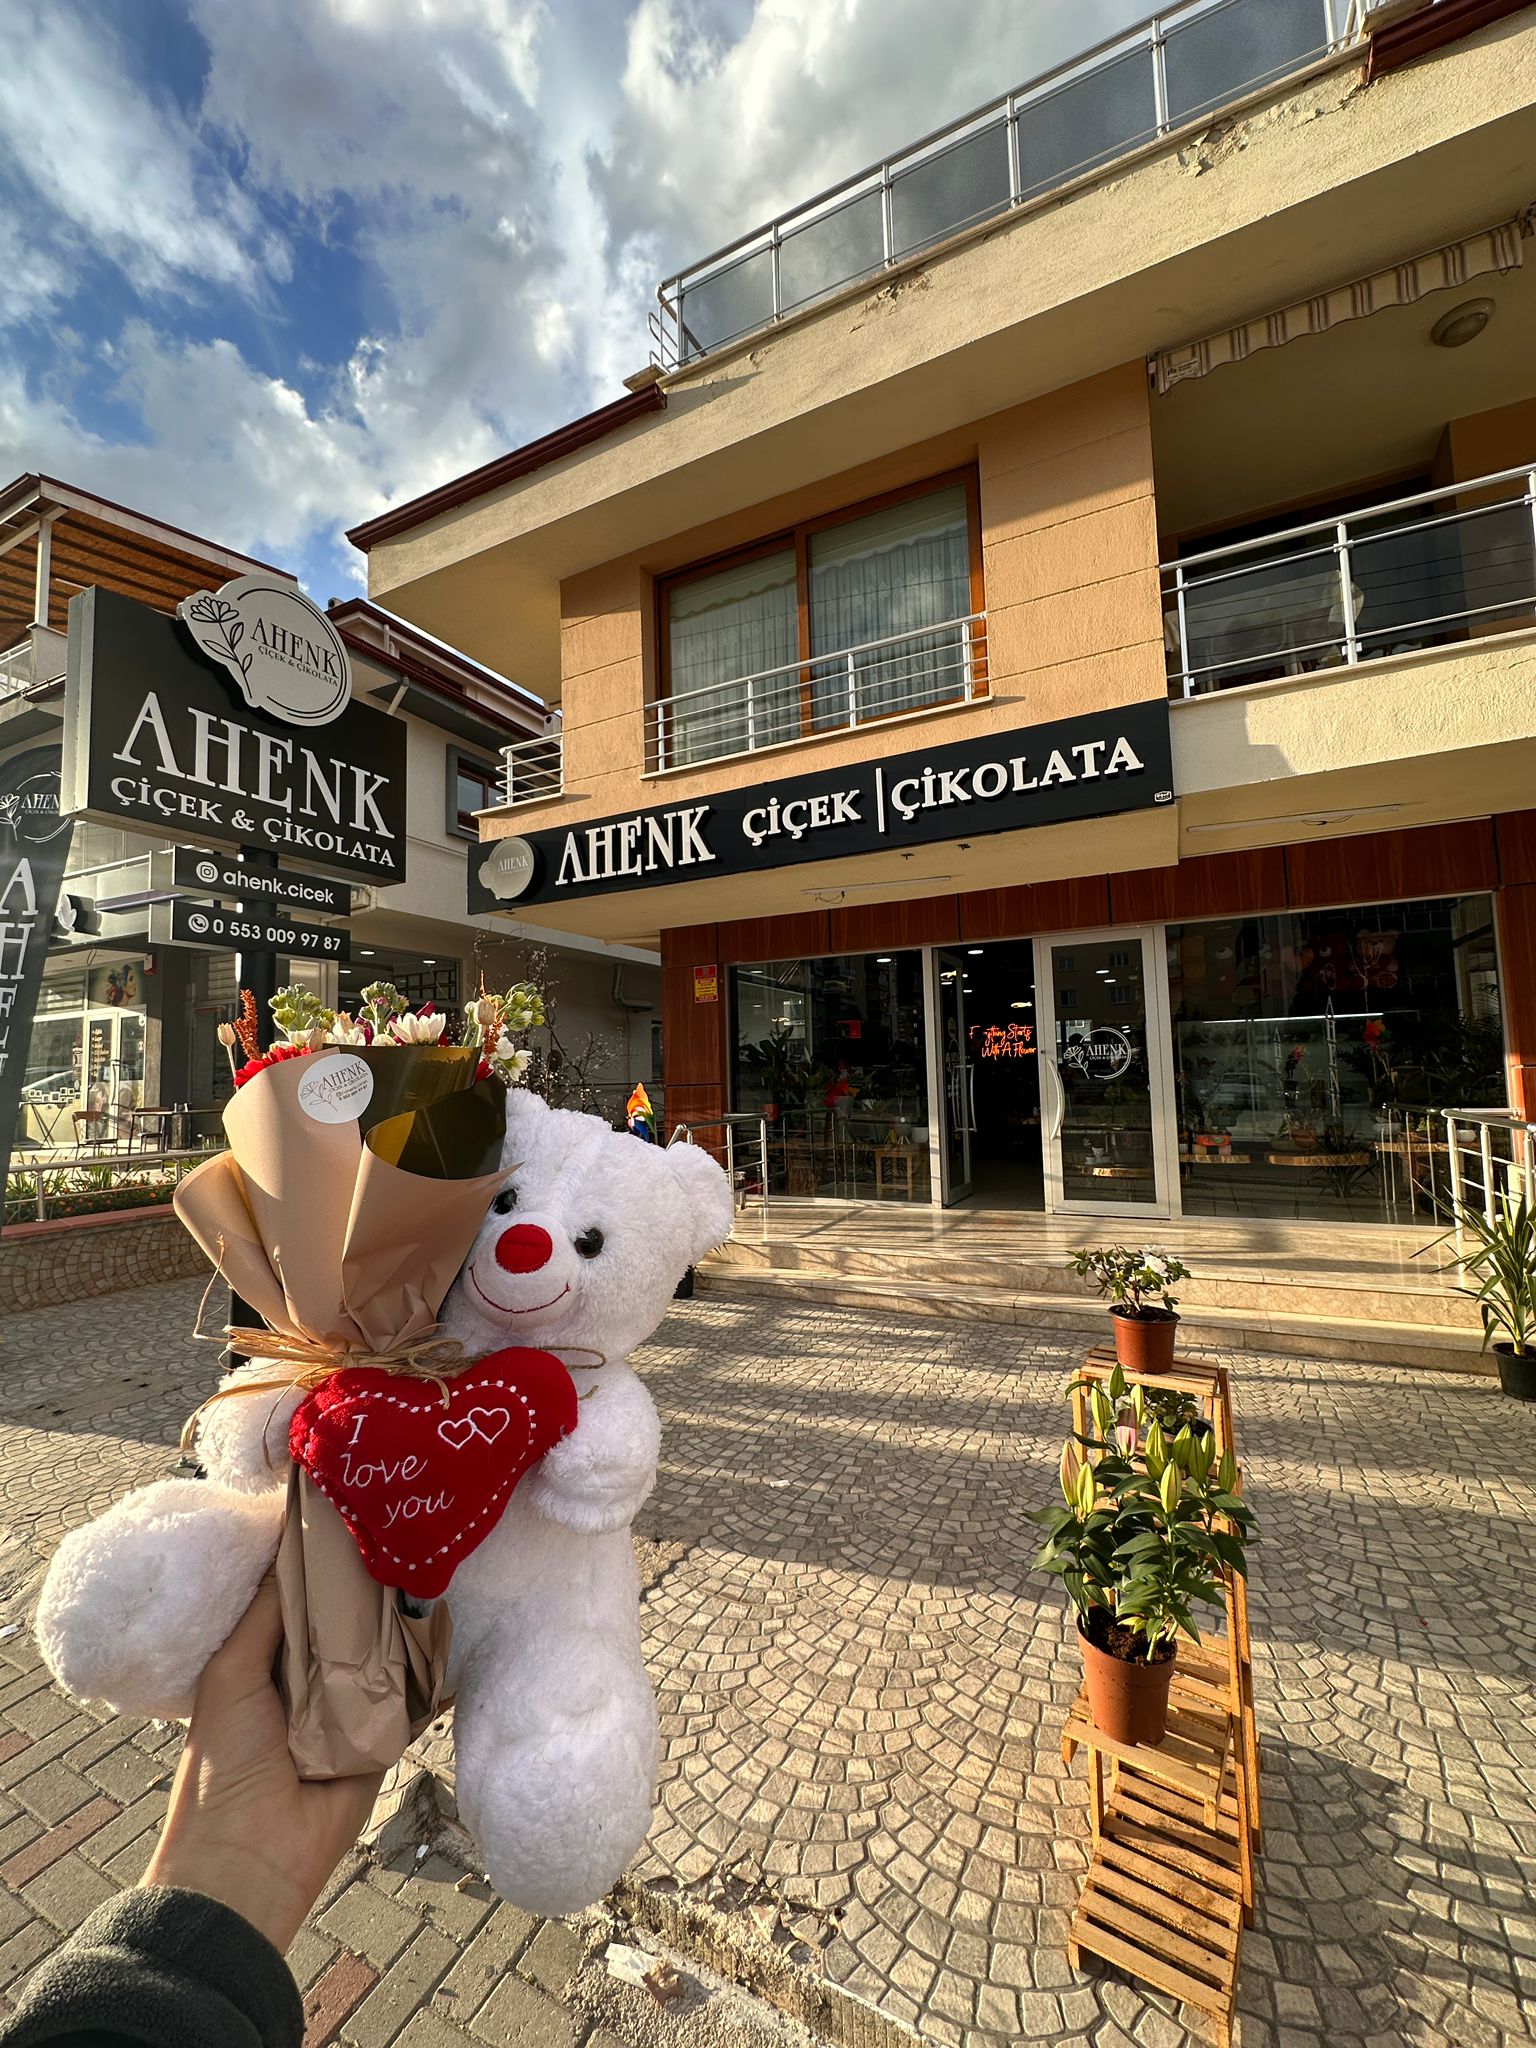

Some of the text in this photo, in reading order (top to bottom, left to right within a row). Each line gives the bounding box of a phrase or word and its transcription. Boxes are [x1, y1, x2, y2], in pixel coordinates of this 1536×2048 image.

[250, 617, 339, 679] AHENK
[288, 659, 294, 667] &
[296, 662, 338, 686] ÇİKOLATA
[112, 691, 395, 839] AHENK
[21, 793, 60, 809] AHEN
[555, 736, 1144, 885] AHENK ÇİÇEK ÇİKOLATA
[110, 776, 396, 868] ÇİÇEK & ÇİKOLATA
[497, 855, 529, 873] AHENK
[223, 870, 334, 904] ahenk.cicek
[213, 918, 341, 951] 0 553 009 97 87
[1085, 1043, 1127, 1056] AHENK
[322, 1060, 366, 1090] AHENK
[347, 1413, 368, 1445] I
[340, 1453, 429, 1488] love
[382, 1489, 454, 1529] you
